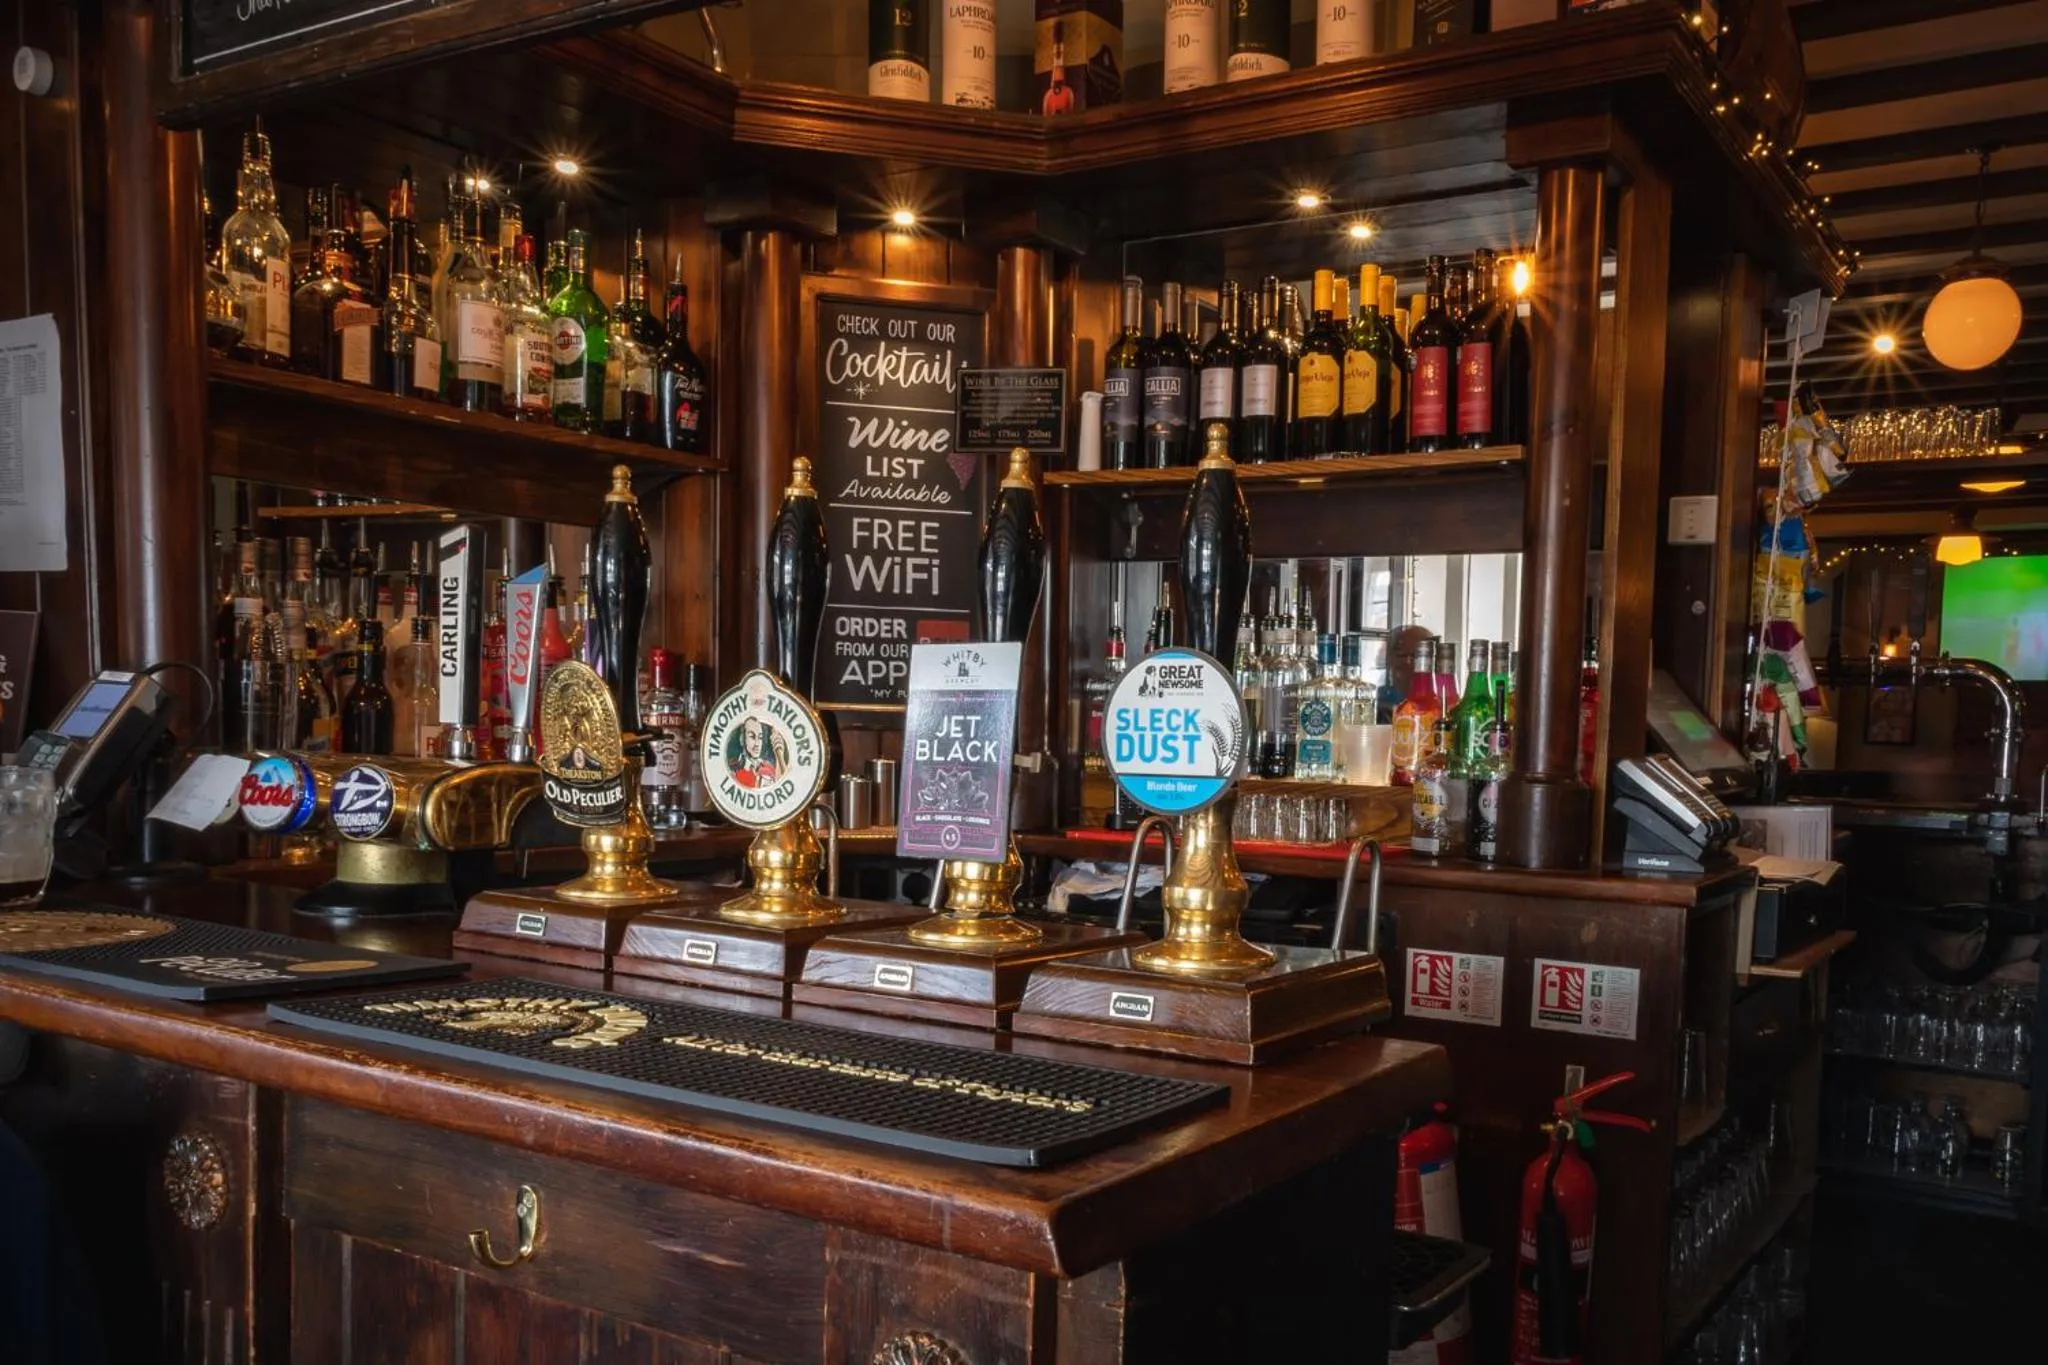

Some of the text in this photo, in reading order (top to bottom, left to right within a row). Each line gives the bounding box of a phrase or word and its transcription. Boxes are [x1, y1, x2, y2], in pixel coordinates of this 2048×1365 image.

[894, 8, 913, 26] 12
[1331, 5, 1347, 22] 10
[972, 45, 985, 60] 10
[1177, 33, 1190, 48] 10
[837, 314, 955, 343] CHECK OUT OUR
[826, 338, 968, 393] Cocktail
[847, 416, 950, 453] Wine
[866, 455, 925, 479] LIST
[839, 479, 951, 504] Available
[852, 517, 940, 553] FREE
[845, 553, 940, 596] WiFi
[440, 576, 460, 678] CARLING
[509, 587, 535, 686] Coors
[835, 616, 908, 640] ORDER
[835, 641, 909, 658] FROM OUR
[941, 650, 988, 668] WHITBY
[839, 659, 908, 686] APP
[1158, 665, 1204, 679] GREAT
[1158, 679, 1204, 689] NEWSOME
[708, 694, 814, 767] TIMOTHY TAYLOR'S
[935, 715, 981, 738] JET
[1115, 707, 1202, 732] SLECK
[915, 739, 999, 762] BLACK
[1115, 733, 1202, 765] DUST
[239, 774, 297, 807] Coors
[545, 779, 624, 807] OLD PECULIER
[720, 776, 795, 811] LANDLORD
[334, 812, 381, 826] STRONGBOW
